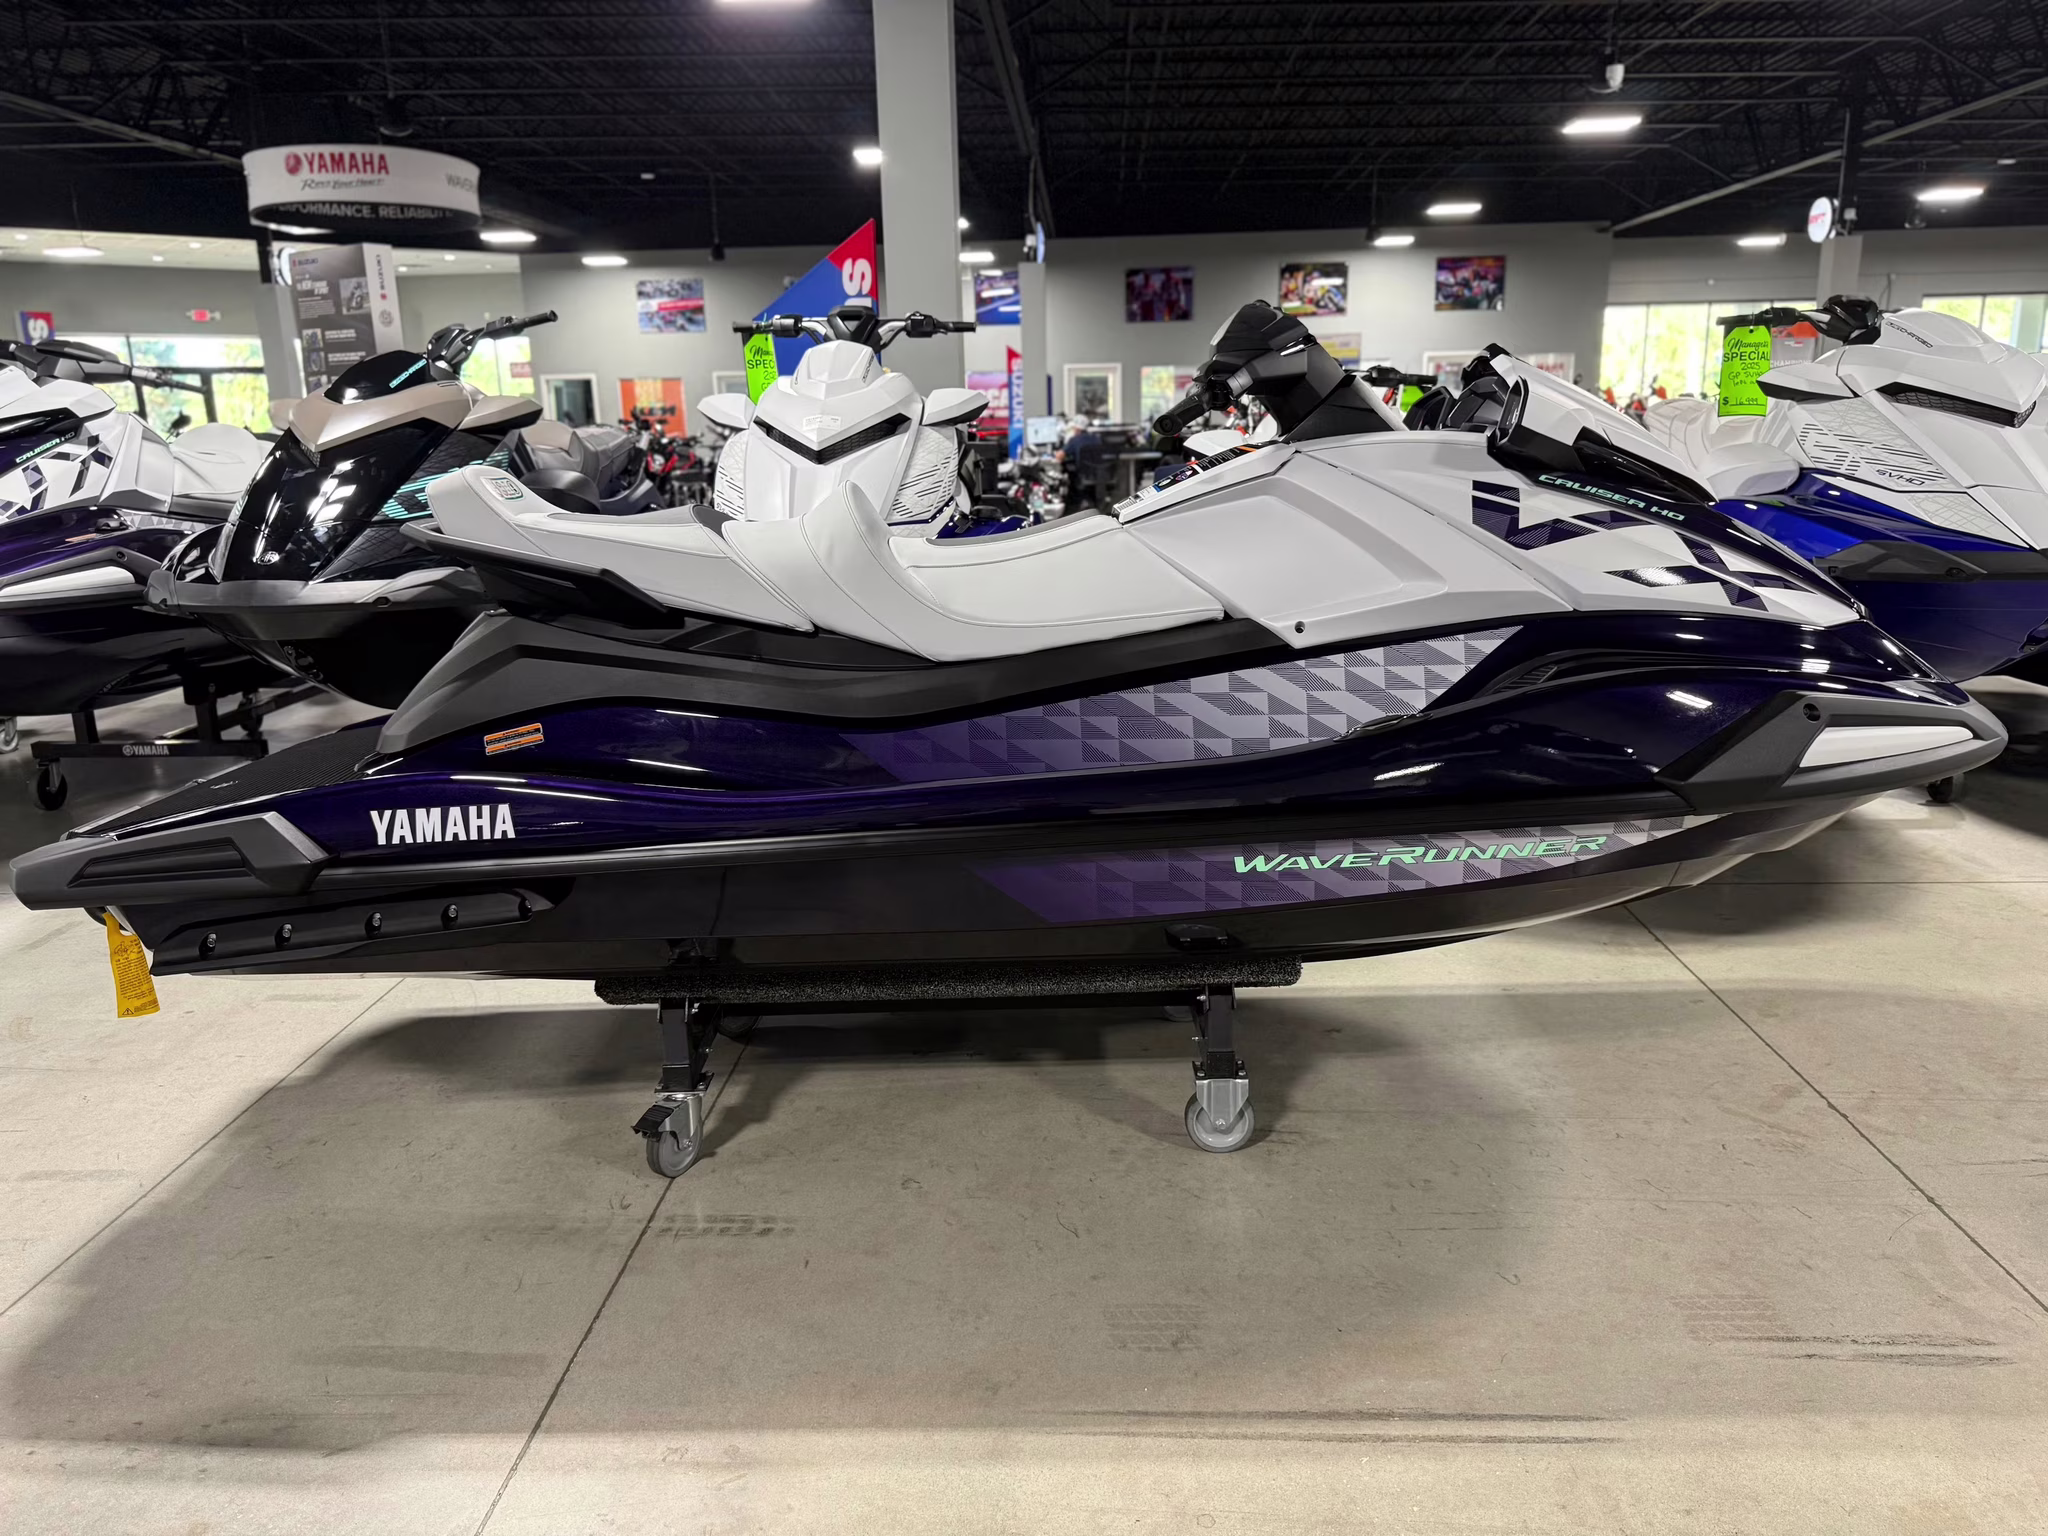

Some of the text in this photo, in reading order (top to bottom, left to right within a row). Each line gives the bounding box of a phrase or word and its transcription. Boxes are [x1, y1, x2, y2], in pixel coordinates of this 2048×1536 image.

[305, 152, 390, 176] YAMAHA
[1723, 350, 1769, 363] SPECIAL
[1740, 361, 1761, 371] 2025
[1011, 358, 1024, 428] SUZUKI
[1722, 396, 1729, 406] $
[15, 438, 60, 464] CRUISER
[1538, 474, 1685, 521] CRUISER HO
[132, 745, 170, 756] YAMAHA
[369, 803, 516, 846] YAMAHA
